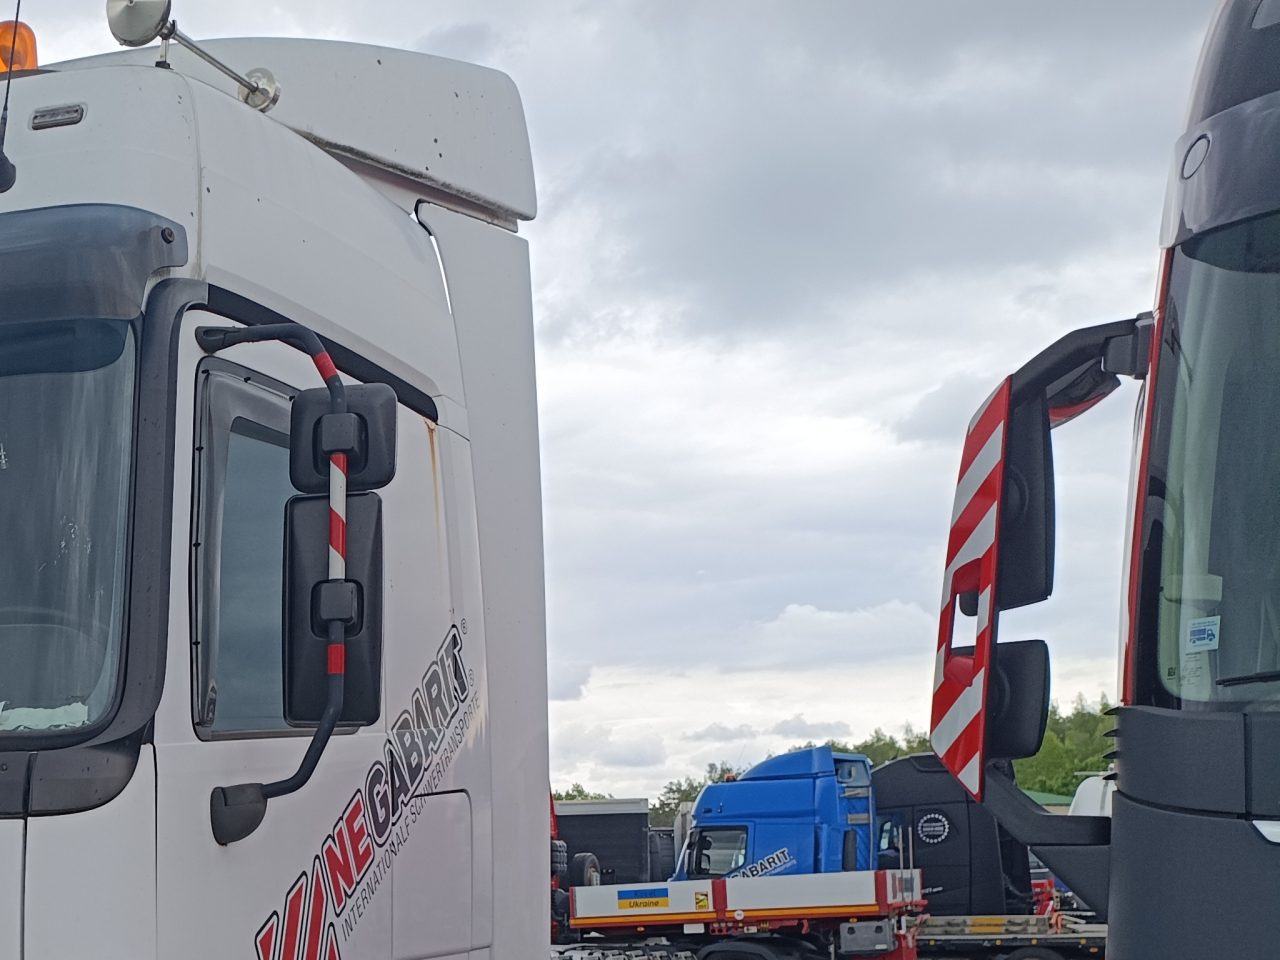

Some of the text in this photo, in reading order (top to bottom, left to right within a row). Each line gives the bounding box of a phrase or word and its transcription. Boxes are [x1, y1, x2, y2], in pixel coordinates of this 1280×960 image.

[322, 624, 469, 917] NEGABARIT
[731, 848, 788, 879] ABARIT
[629, 901, 659, 909] Ukraine
